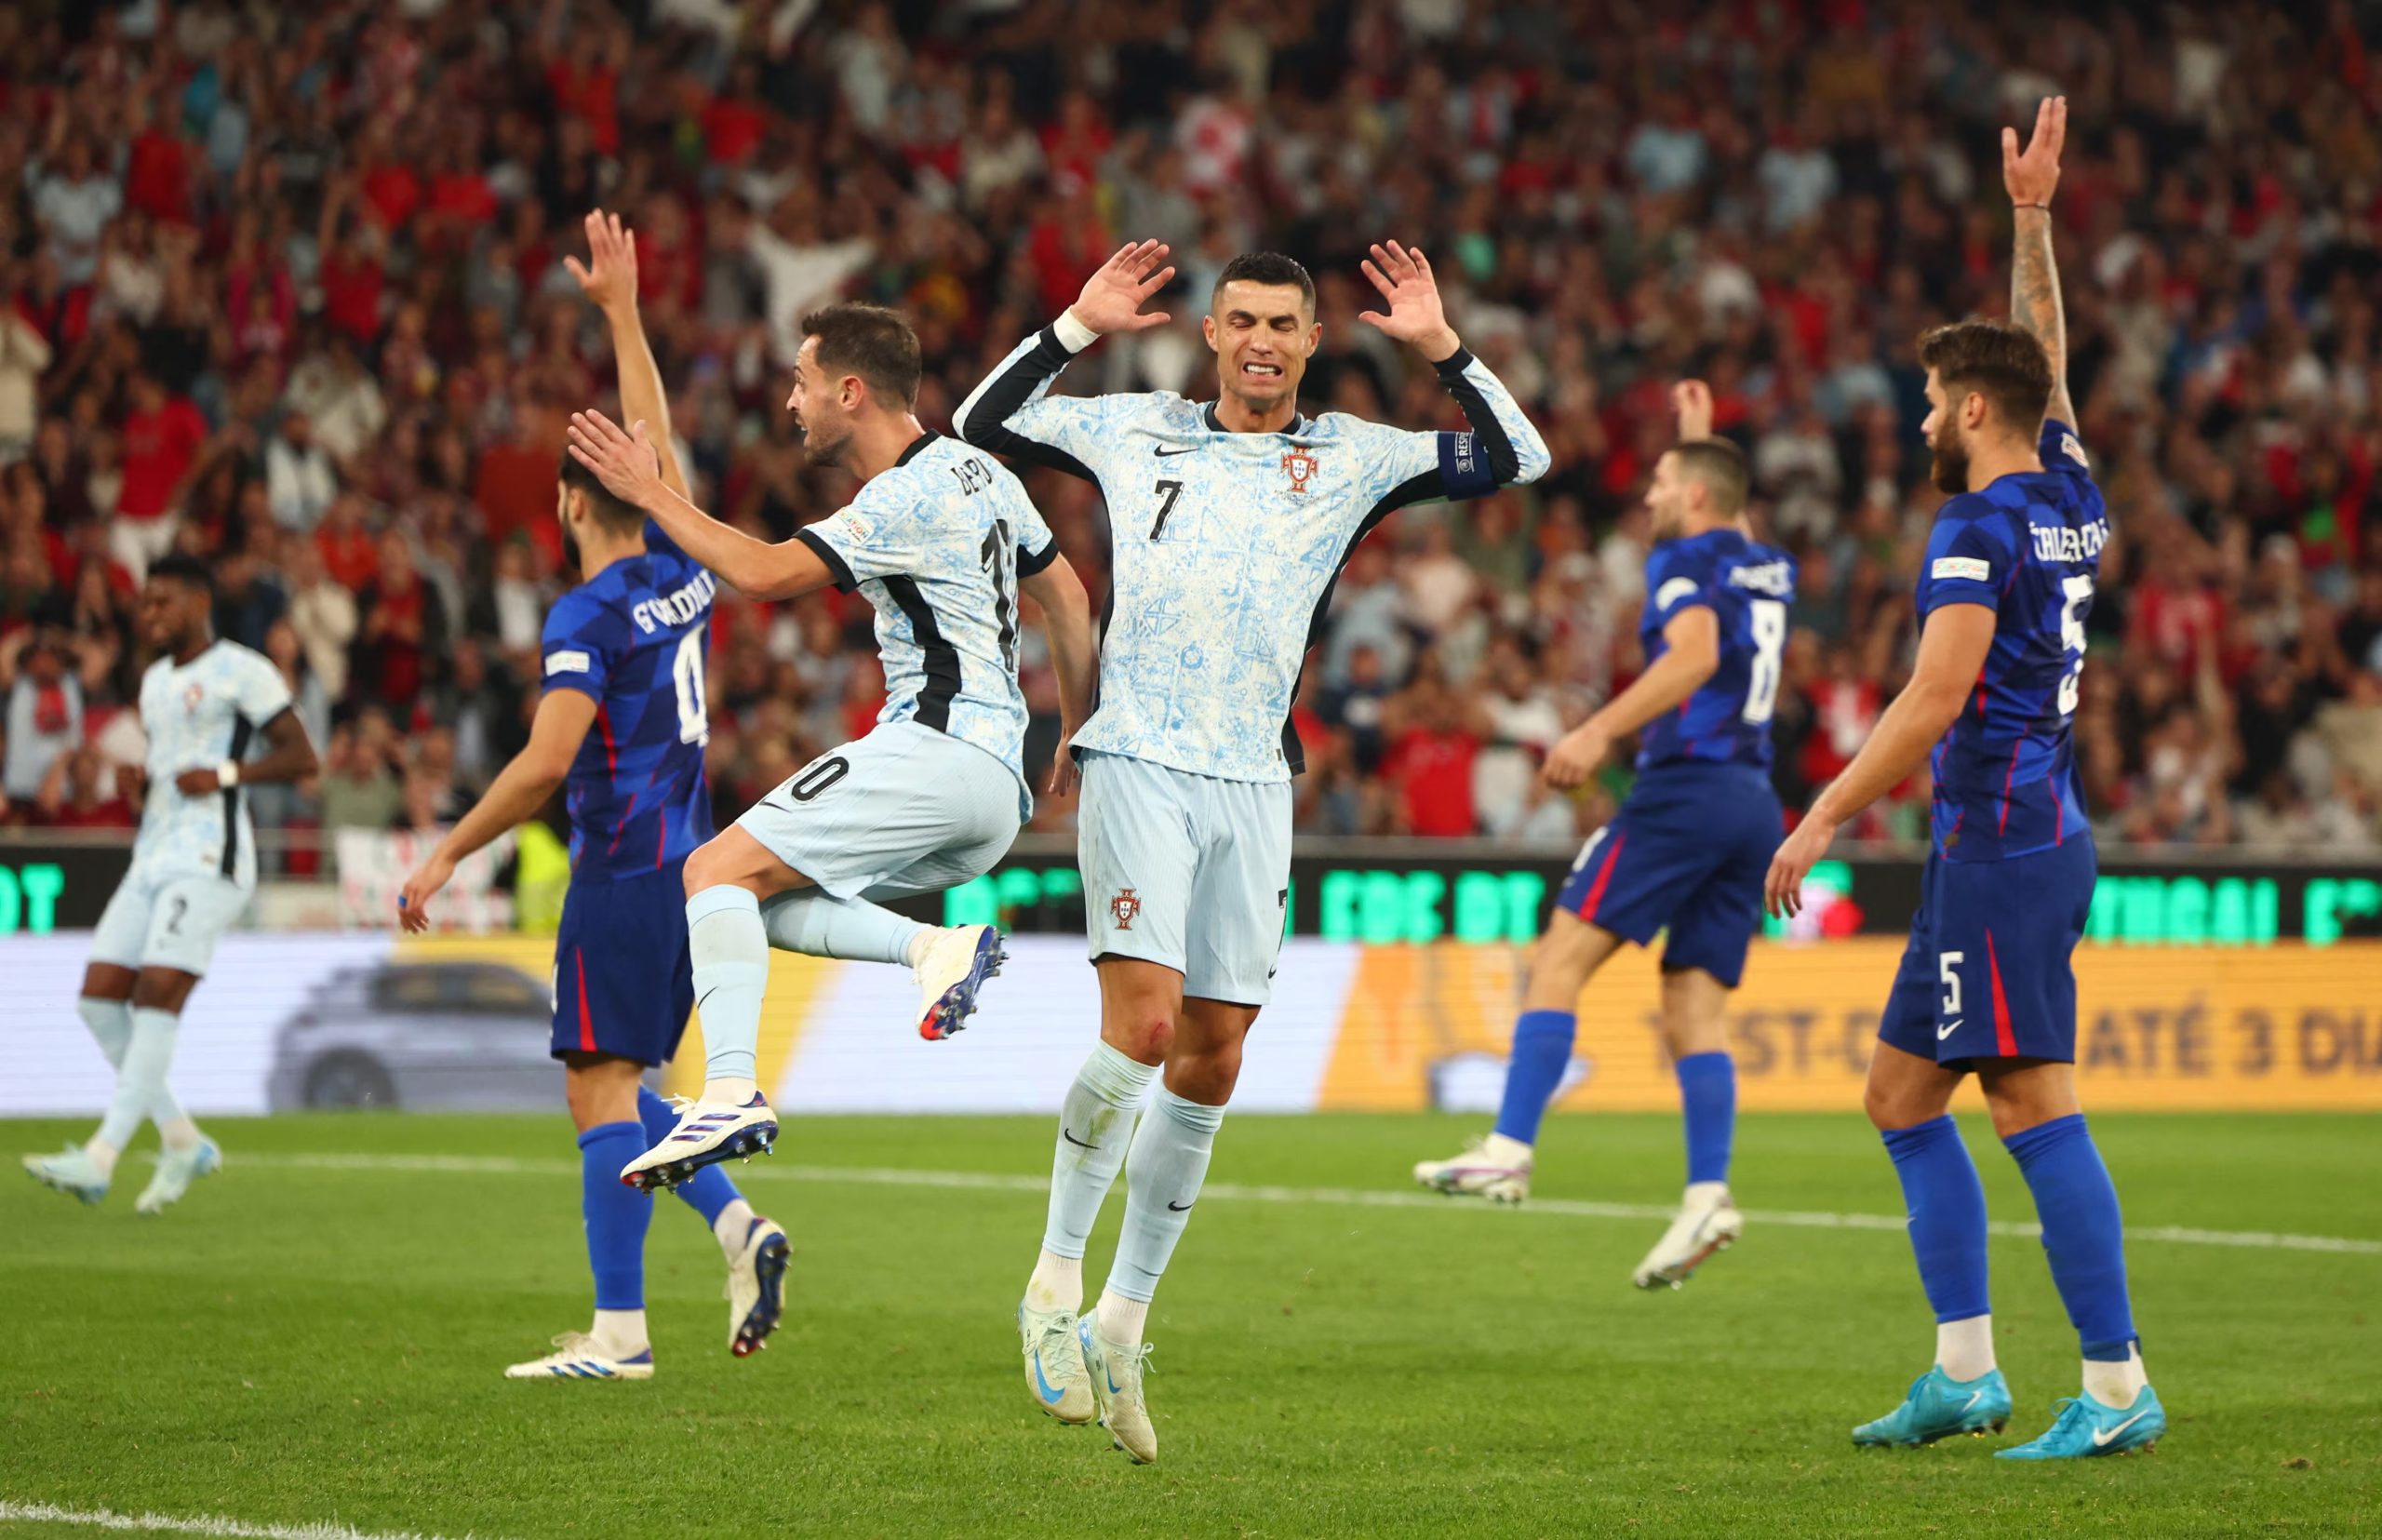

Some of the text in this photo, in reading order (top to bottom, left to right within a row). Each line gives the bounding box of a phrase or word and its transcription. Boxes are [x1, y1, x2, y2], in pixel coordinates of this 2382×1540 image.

[1149, 479, 1184, 543] 7
[1742, 597, 1786, 726] 8
[2057, 574, 2093, 716] 5
[167, 893, 188, 935] 2
[1939, 951, 1964, 1015] 5
[2084, 989, 2211, 1077] ATÉ
[2230, 1007, 2274, 1077] 3
[2296, 1007, 2382, 1077] DI
